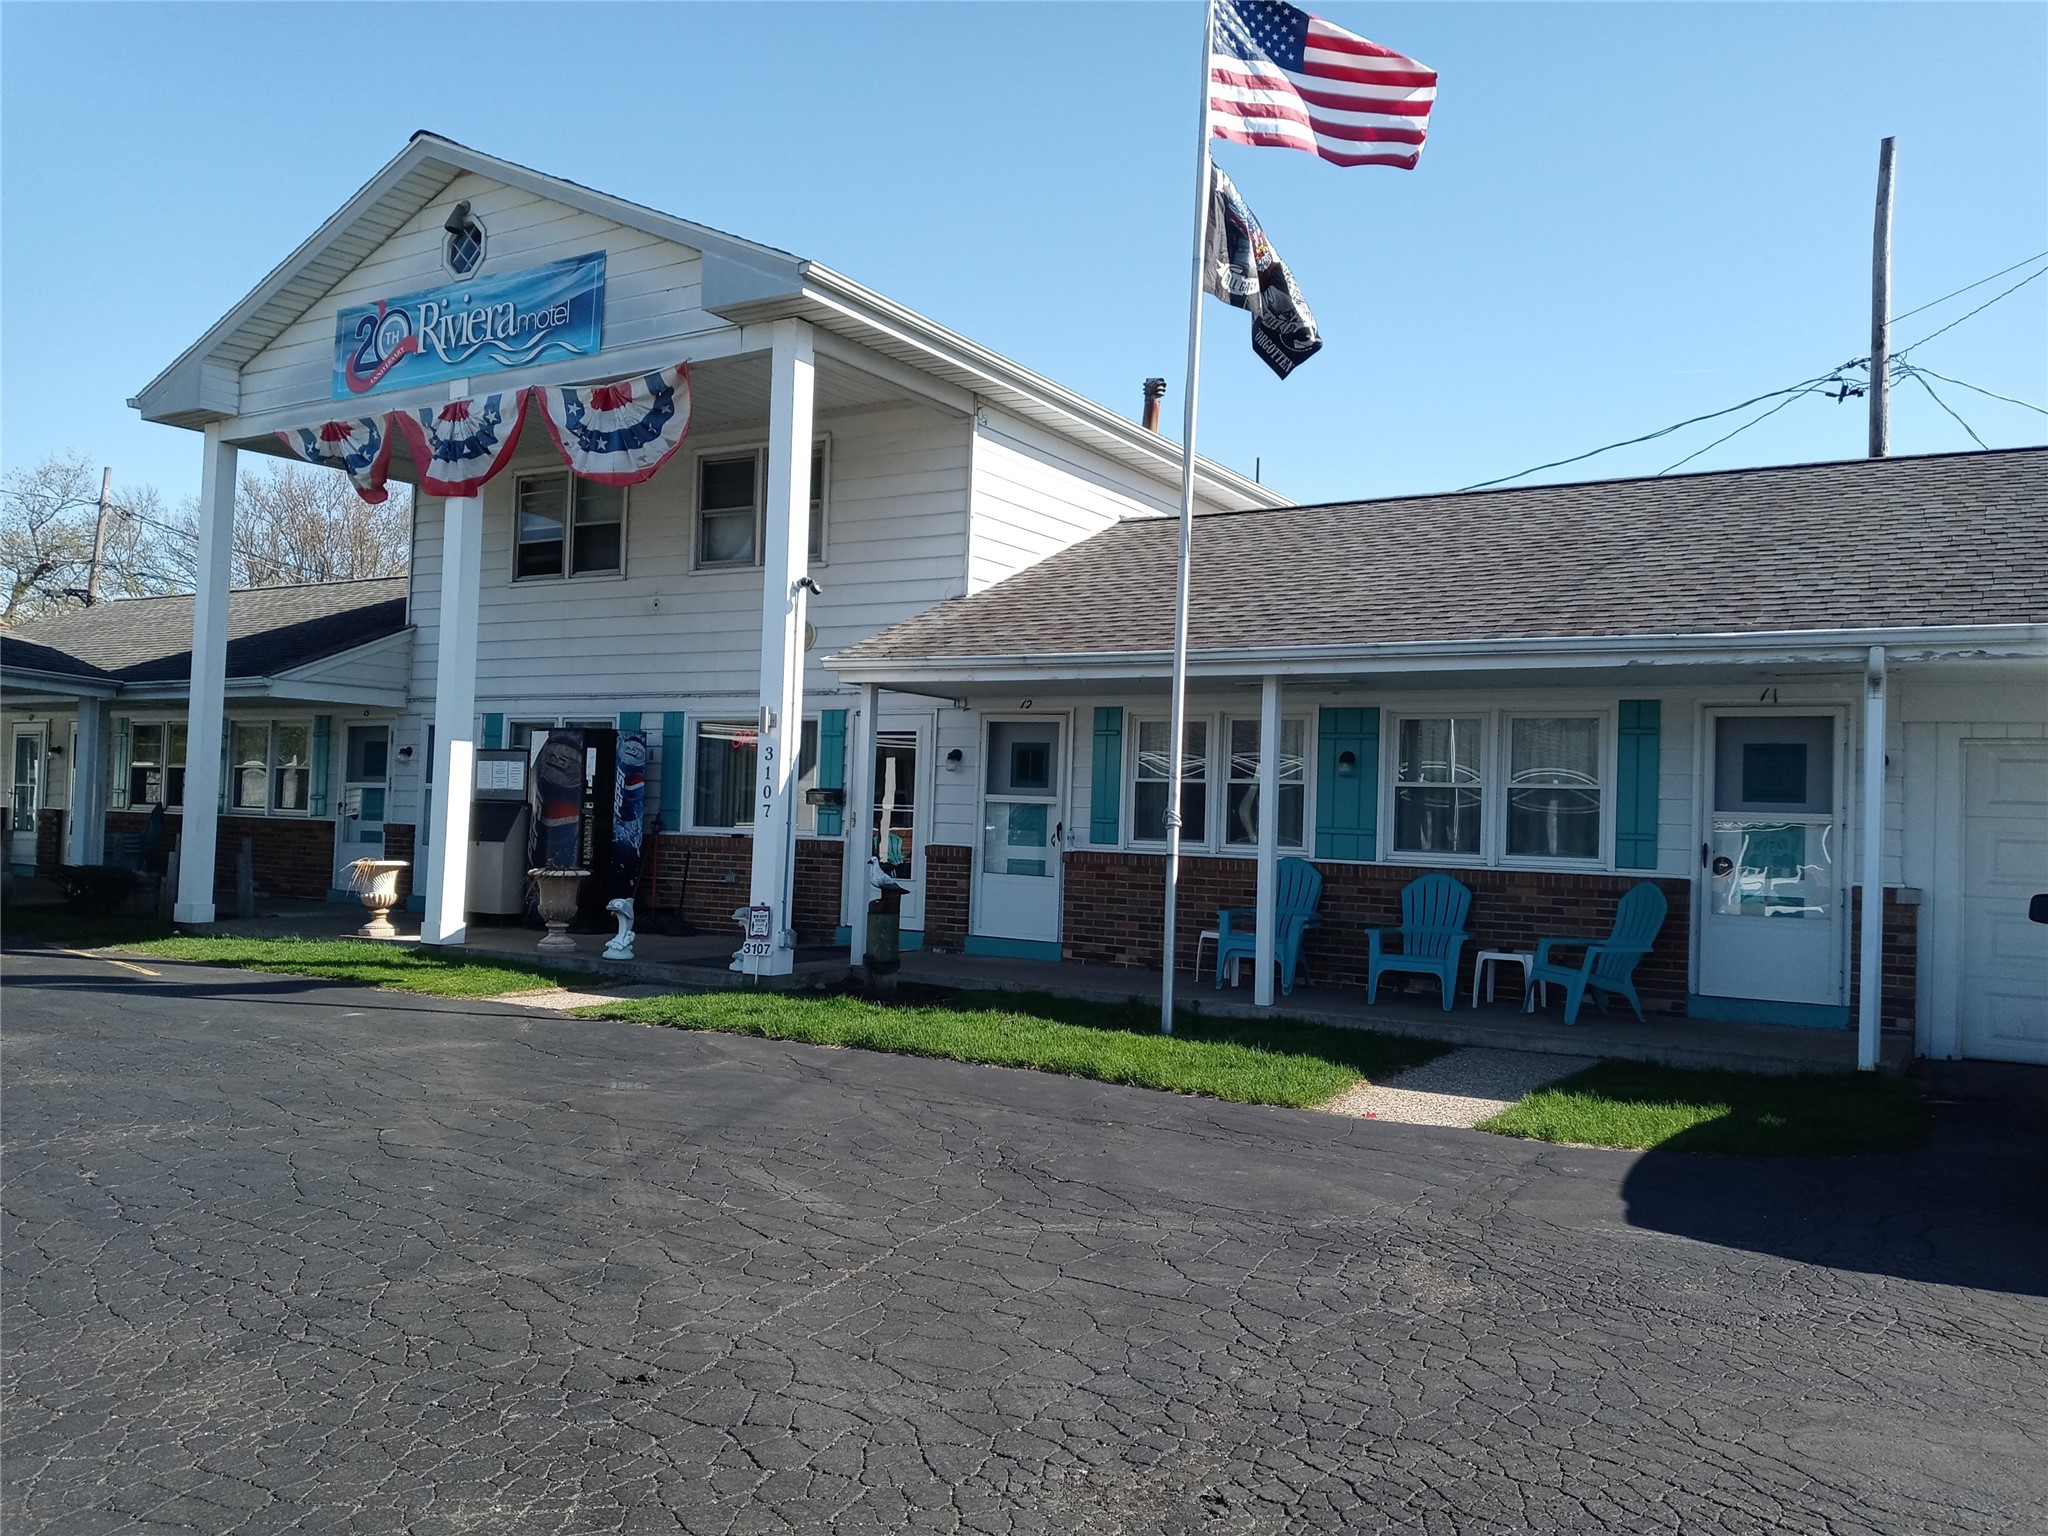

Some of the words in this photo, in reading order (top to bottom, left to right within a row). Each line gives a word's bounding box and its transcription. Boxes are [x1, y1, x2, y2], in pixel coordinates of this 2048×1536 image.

[417, 293, 518, 354] Riviera
[517, 299, 571, 333] motel
[1254, 328, 1295, 372] ORGOTTEN
[732, 731, 758, 748] OPE
[613, 765, 626, 818] PEPSI
[763, 746, 774, 818] 3107
[743, 942, 771, 955] 3107
